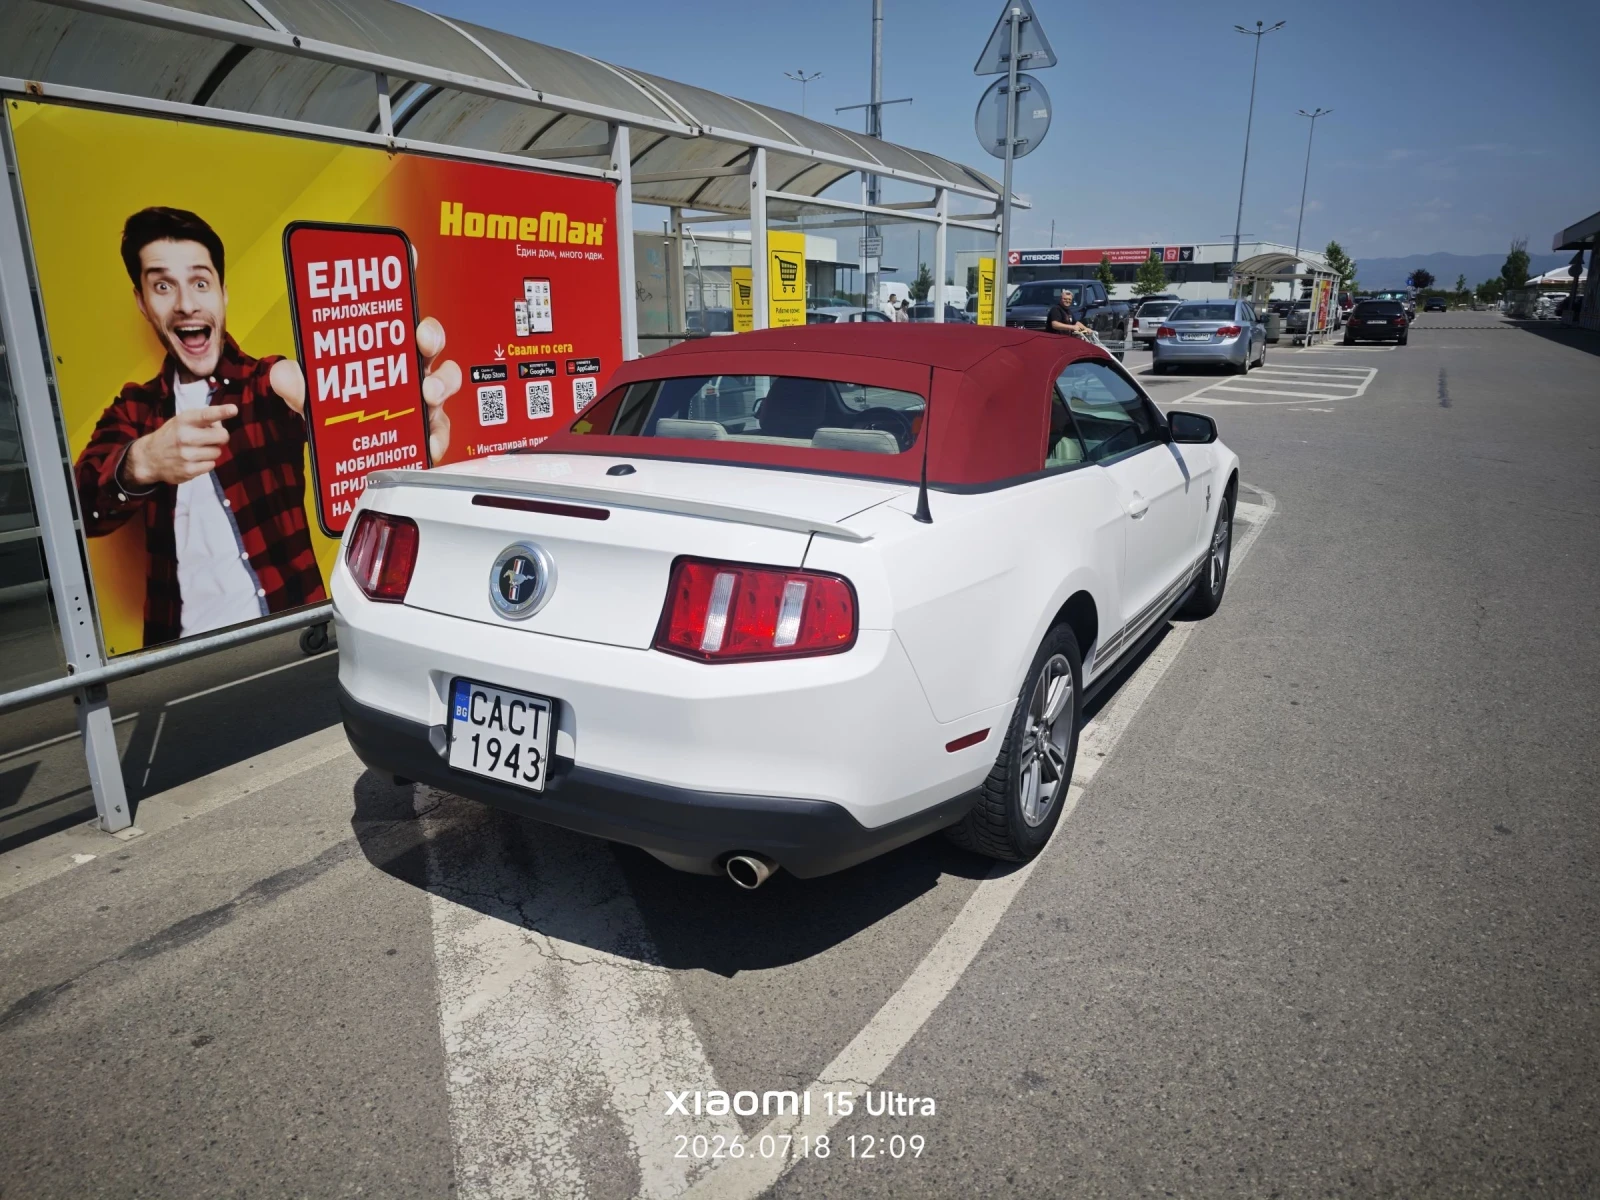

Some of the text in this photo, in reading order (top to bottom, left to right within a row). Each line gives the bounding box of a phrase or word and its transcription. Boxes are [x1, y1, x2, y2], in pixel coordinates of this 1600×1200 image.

[516, 244, 604, 261] Един дом, много идеи.
[307, 255, 402, 302] ЕДНО
[312, 298, 403, 323] ПРИЛОЖЕНИЕ
[313, 319, 406, 359] МНОГО
[507, 343, 573, 356] Свали го сега
[316, 353, 408, 403] ИДЕИ
[529, 366, 555, 376] Google Play
[352, 429, 398, 452] СВАЛИ
[467, 445, 476, 456] 1:
[477, 438, 528, 454] Инсталирай
[335, 444, 418, 476] МОБИЛНОТО
[332, 500, 353, 517] НА
[455, 705, 468, 717] BG
[471, 733, 541, 782] 1943
